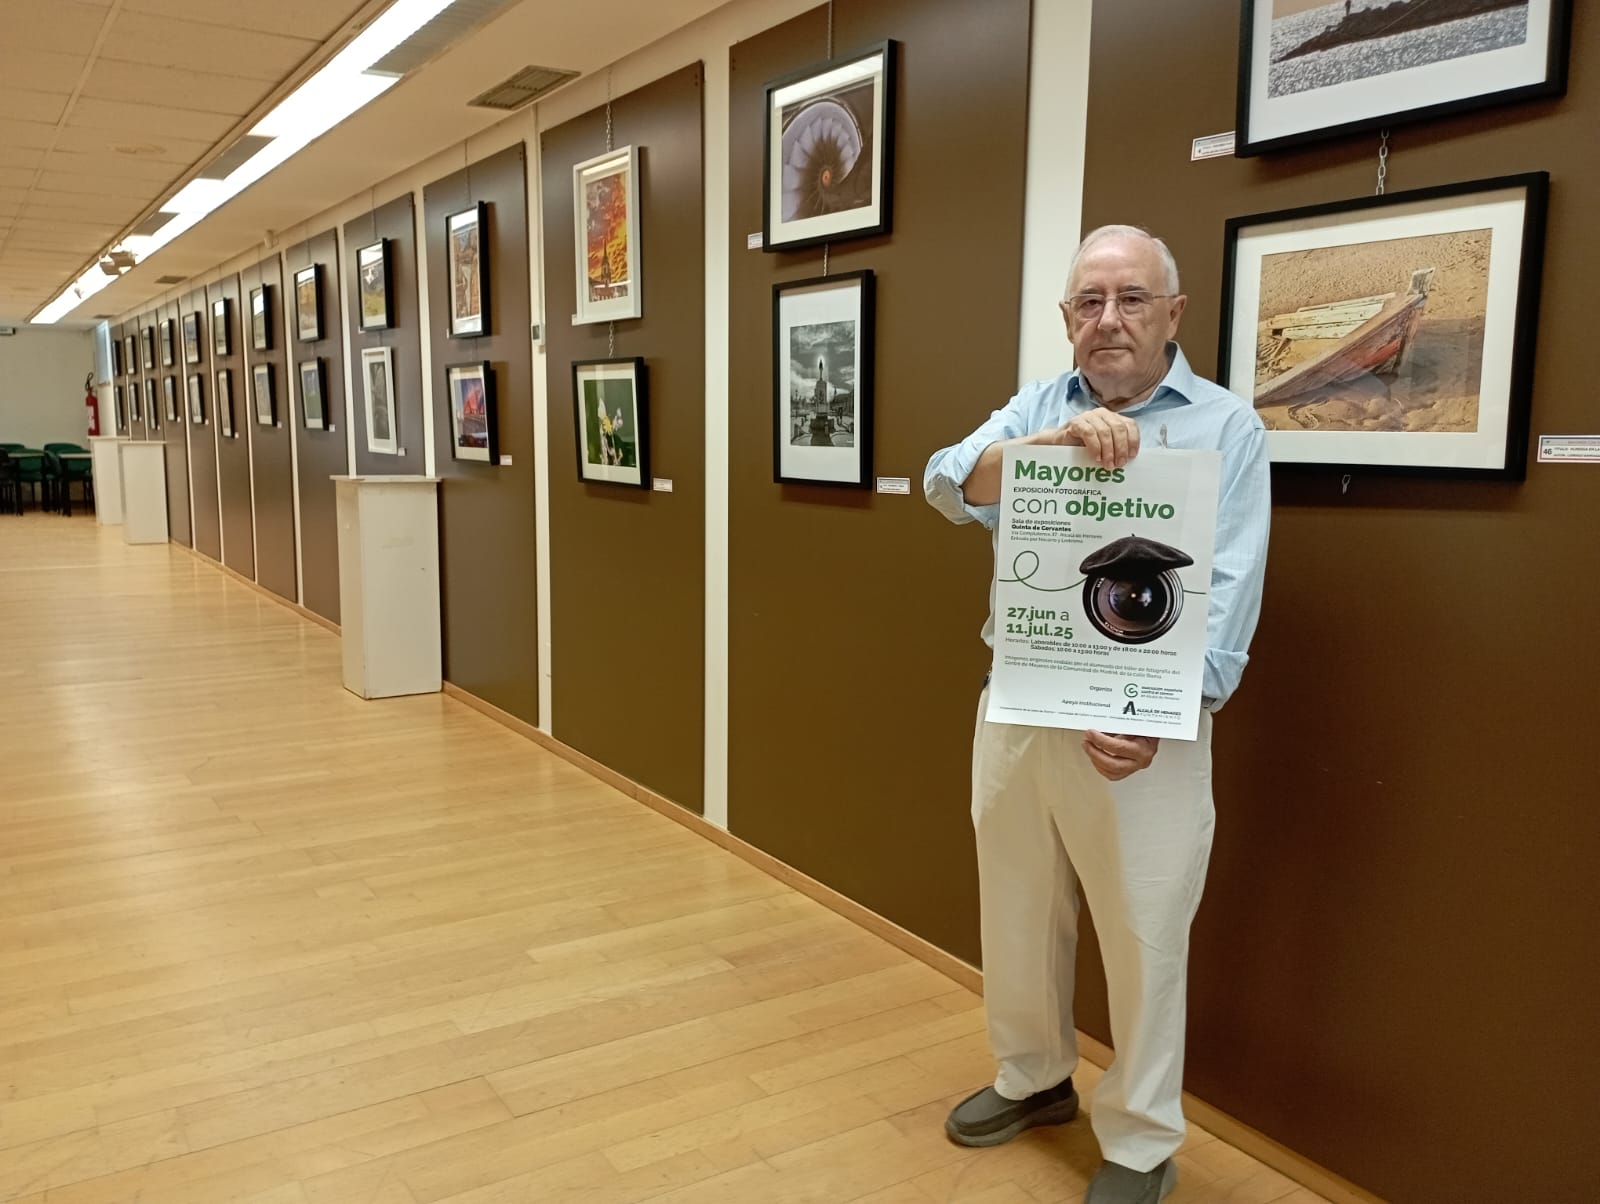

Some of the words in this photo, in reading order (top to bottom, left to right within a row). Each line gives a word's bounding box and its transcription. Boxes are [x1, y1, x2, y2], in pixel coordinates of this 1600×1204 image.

[1014, 460, 1125, 486] Mayores
[1012, 498, 1057, 514] con
[1066, 496, 1174, 521] objetivo
[1007, 606, 1056, 621] 27.jun
[1060, 611, 1069, 621] a
[1006, 622, 1073, 639] 11.jul.25
